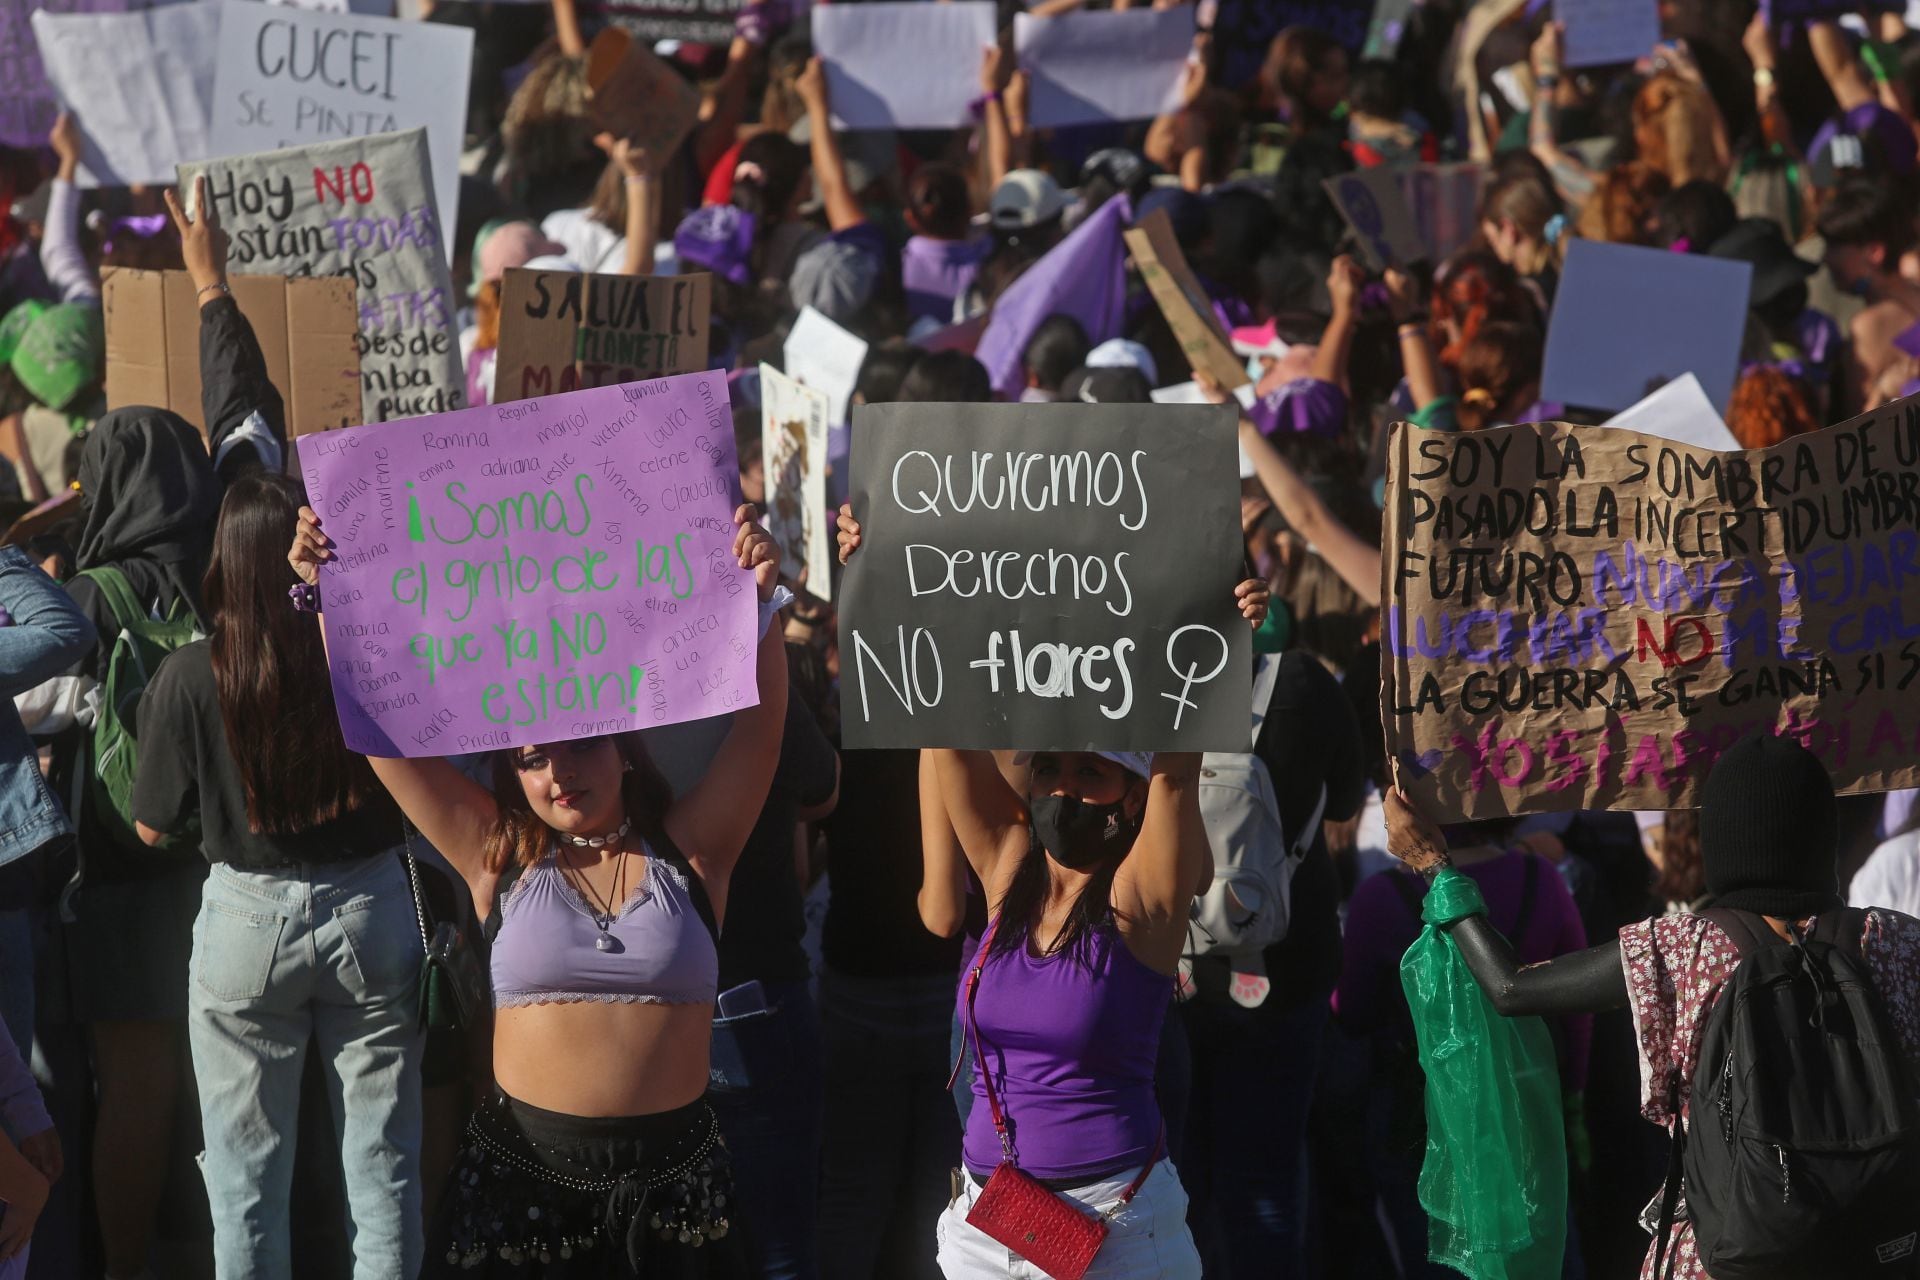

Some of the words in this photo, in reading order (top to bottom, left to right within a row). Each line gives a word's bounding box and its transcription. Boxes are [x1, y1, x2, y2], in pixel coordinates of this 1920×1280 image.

[257, 19, 402, 100] CUCEI
[235, 90, 273, 127] SE
[296, 97, 398, 136] PINTA
[207, 170, 294, 222] Hoy
[313, 162, 375, 205] NO
[327, 206, 438, 250] TODAS
[525, 273, 649, 331] SALVA
[671, 281, 697, 336] EL
[422, 432, 490, 451] Romina
[498, 401, 540, 423] Regina
[315, 435, 360, 456] Lupe
[480, 456, 541, 477] adriana
[1410, 433, 1512, 487] SOY
[1536, 434, 1585, 480] LA
[1619, 443, 1820, 508] SOMBRA
[1834, 420, 1879, 484] DE
[405, 474, 594, 545] ¡Somos
[892, 450, 1147, 530] Queremos
[1408, 486, 1553, 540] PASADO
[1566, 486, 1618, 538] LA
[391, 561, 428, 617] el
[444, 546, 542, 622] grito
[552, 546, 619, 593] de
[636, 533, 694, 600] las
[1394, 547, 1581, 616] FUTURO
[1592, 540, 1766, 614] NUNCA
[409, 632, 483, 688] que
[551, 612, 607, 667] NO
[1390, 604, 1628, 666] LUCHAR
[1637, 616, 1714, 669] NO
[1723, 608, 1815, 669] ME
[481, 664, 645, 727] están!
[852, 625, 943, 721] NO
[970, 630, 1135, 720] flores
[1390, 671, 1445, 716] LA
[1460, 668, 1641, 714] GUERRA
[1651, 674, 1700, 717] SE
[1718, 657, 1842, 707] GANA
[1856, 652, 1885, 696] SI
[1451, 715, 1534, 792] YO
